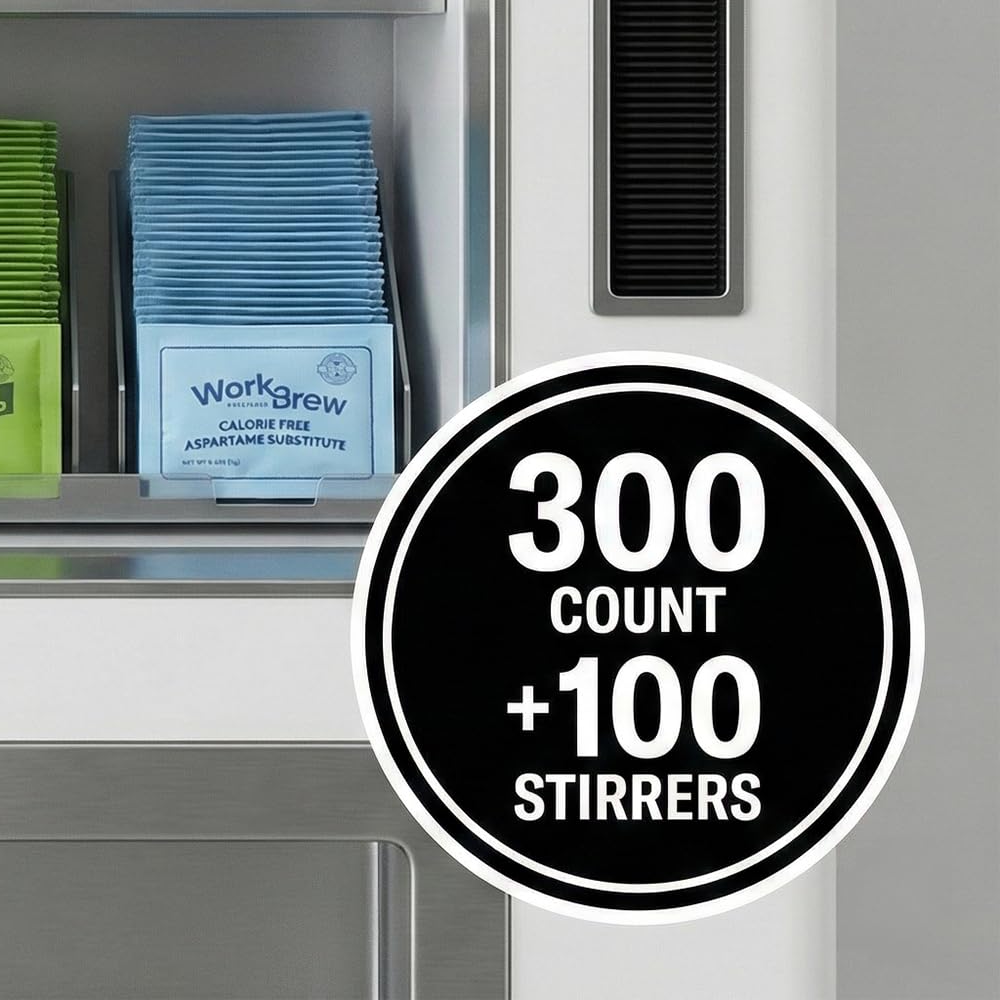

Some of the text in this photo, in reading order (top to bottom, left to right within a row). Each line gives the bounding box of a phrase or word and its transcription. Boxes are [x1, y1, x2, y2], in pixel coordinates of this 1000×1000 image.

[190, 373, 348, 416] WorkBrew
[218, 418, 312, 432] CALORIE FREE
[184, 433, 347, 452] ASPARTAME SUBSTITUTE
